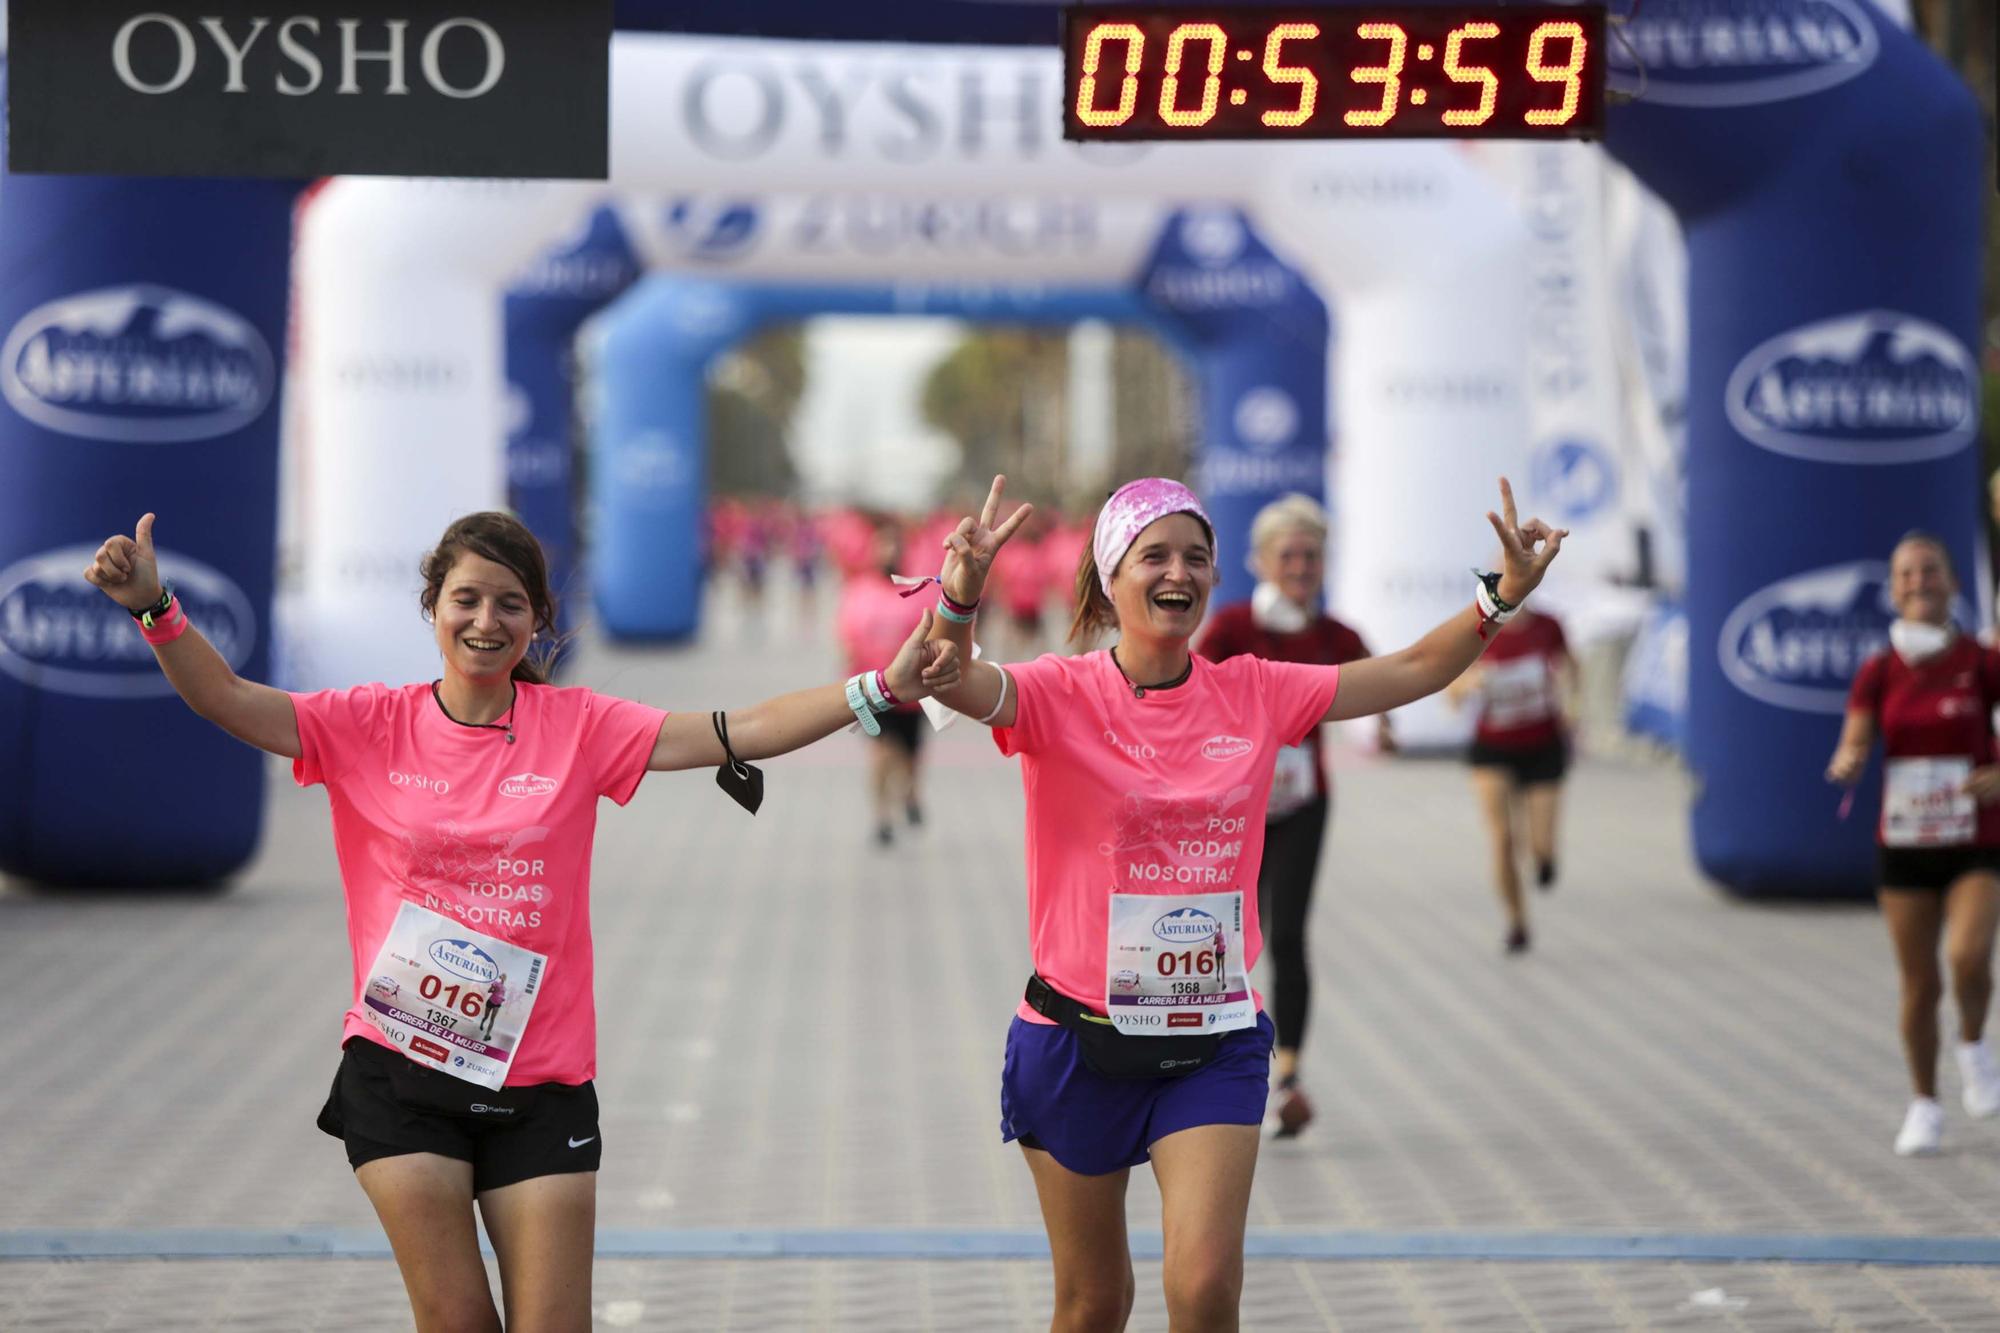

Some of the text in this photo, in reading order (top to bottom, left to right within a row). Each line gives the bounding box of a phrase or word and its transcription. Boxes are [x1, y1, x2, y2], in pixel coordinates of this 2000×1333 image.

[111, 13, 506, 99] OYSHO
[1076, 22, 1587, 127] 00:53:59
[682, 58, 1160, 166] OYSH
[1207, 816, 1246, 833] POR
[1177, 840, 1241, 858] TODAS
[498, 859, 544, 875] POR
[466, 881, 543, 902] TODAS
[1159, 922, 1214, 935] ASTURIANA
[433, 945, 493, 980] ASTURIANA
[1157, 950, 1214, 976] 016
[419, 974, 484, 1018] 016
[1171, 982, 1200, 994] 1368
[1137, 994, 1226, 1005] CARRERA DE LA MUJER
[427, 1009, 458, 1030] 1367
[1113, 1014, 1161, 1026] OYSHO
[388, 1008, 429, 1032] CARRERA
[429, 1024, 442, 1036] DE
[443, 1030, 454, 1041] LA
[455, 1036, 487, 1053] MUJER
[466, 1062, 495, 1077] ZURICH
